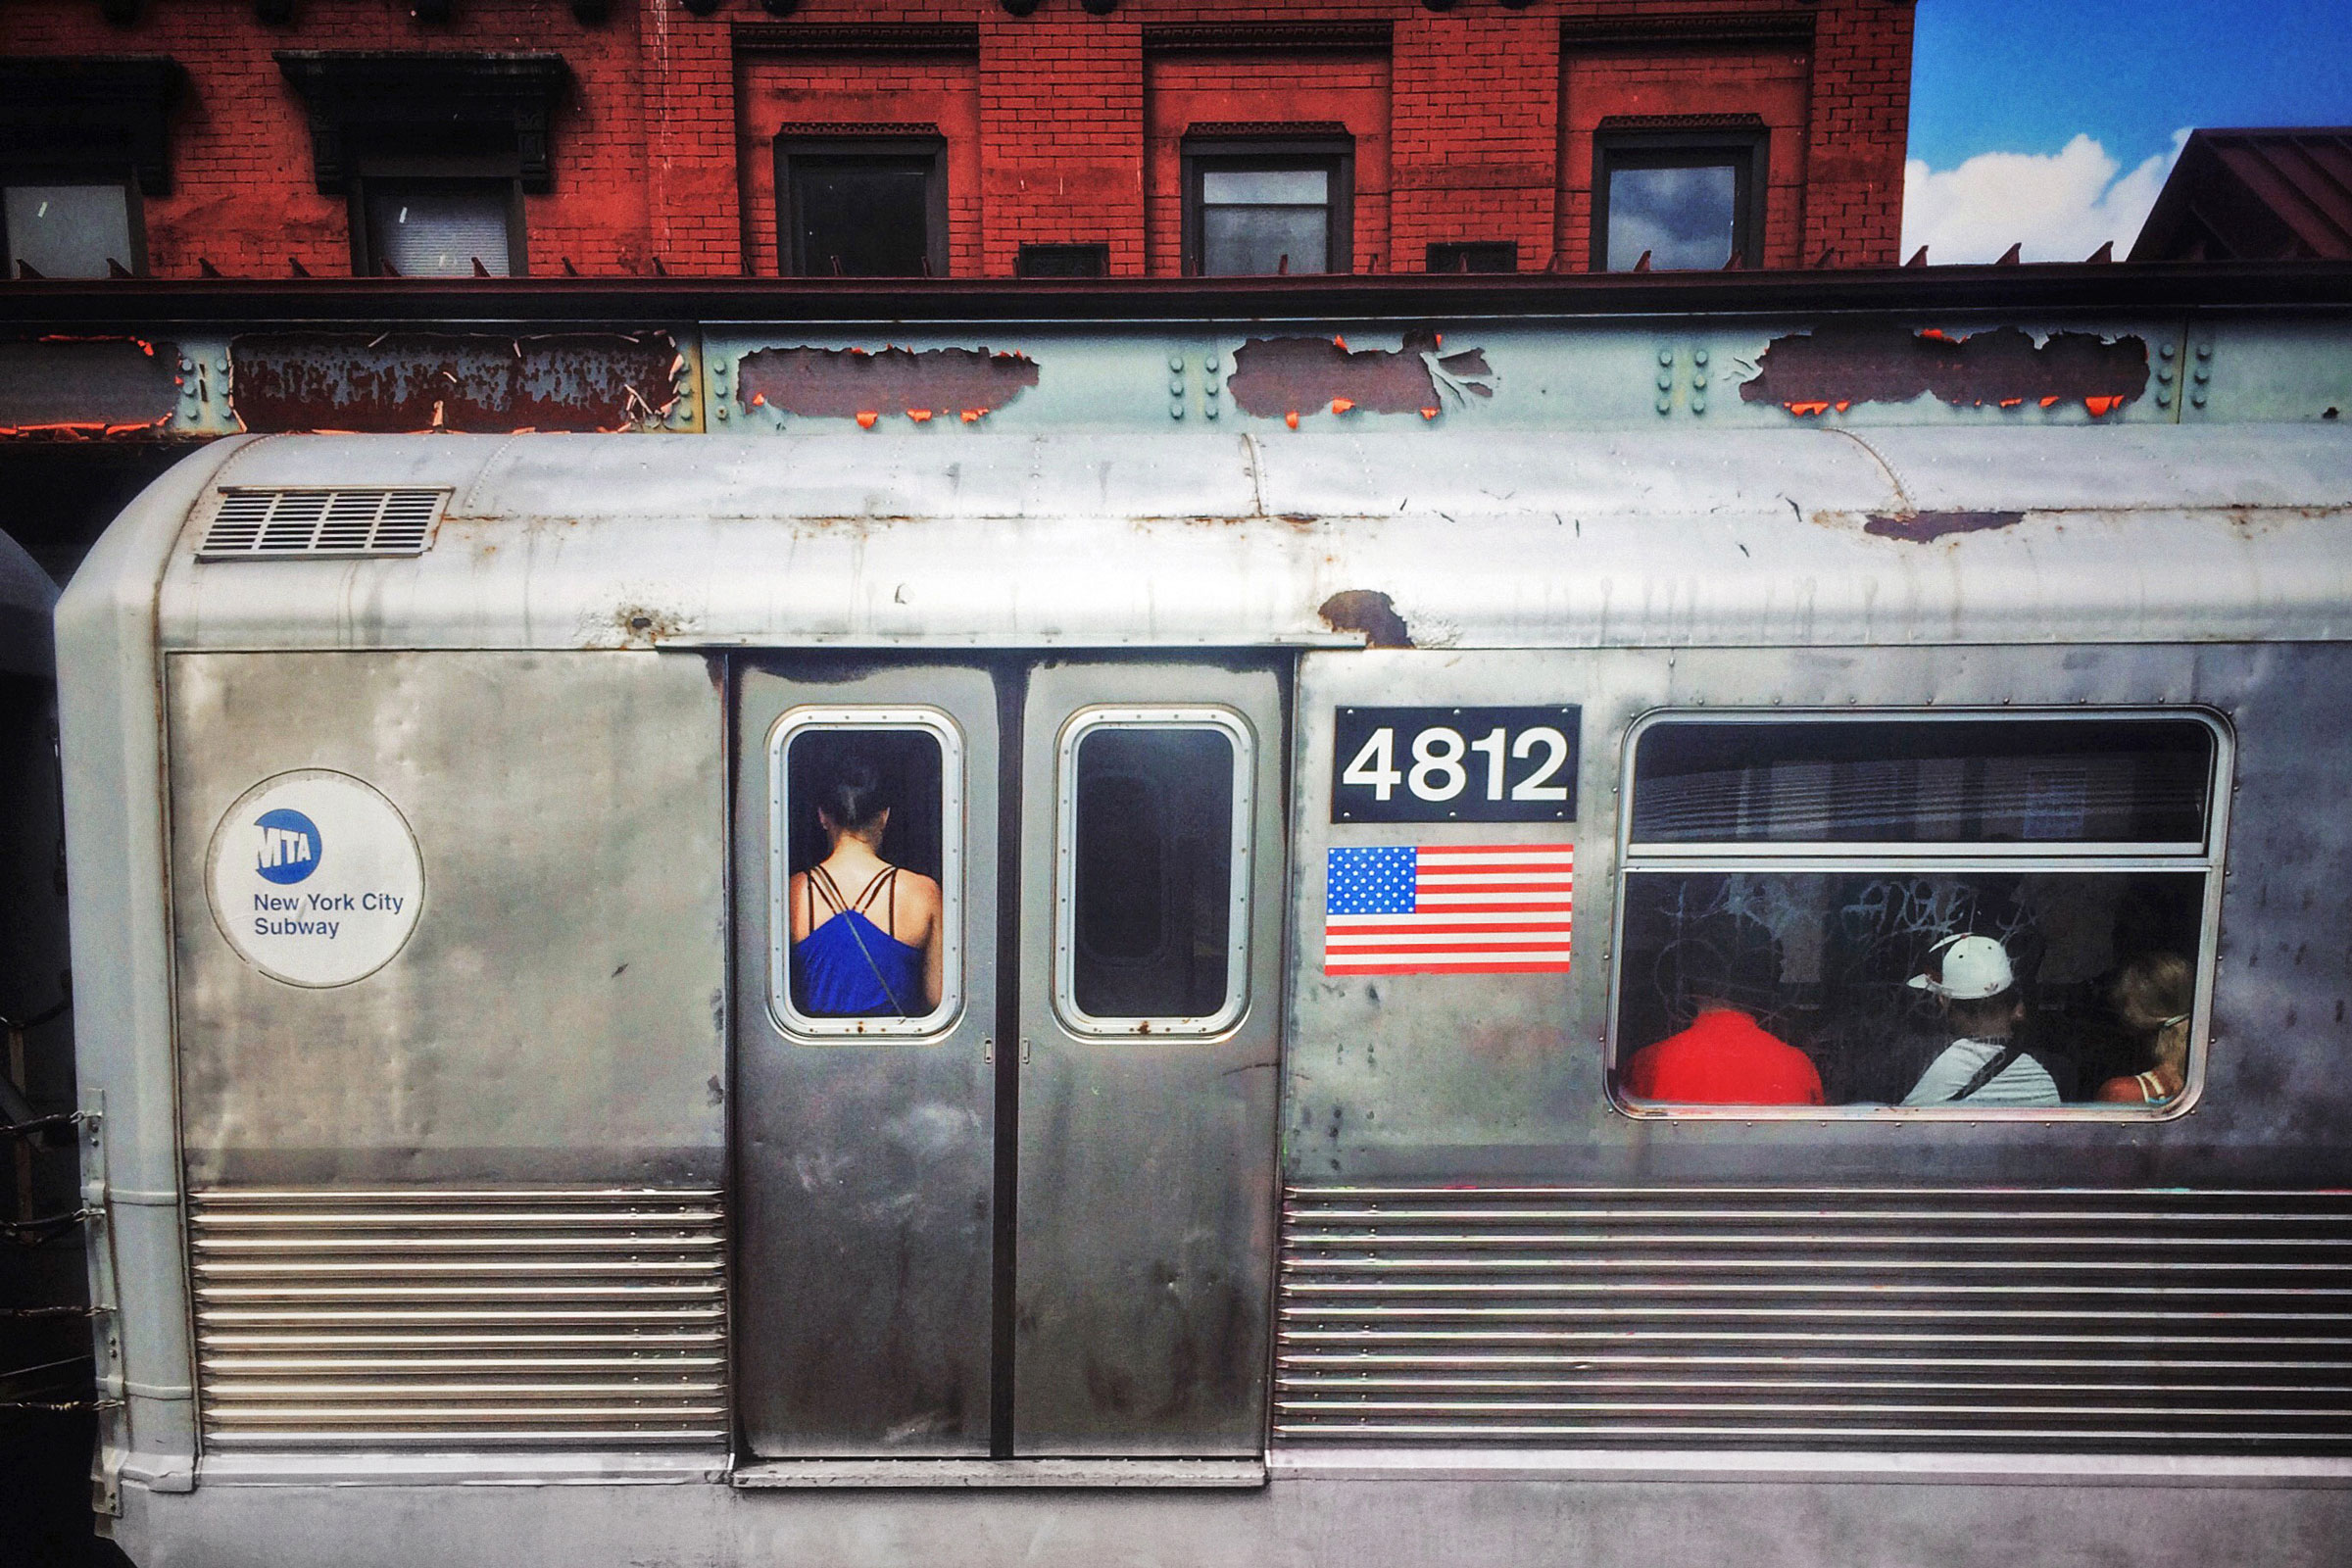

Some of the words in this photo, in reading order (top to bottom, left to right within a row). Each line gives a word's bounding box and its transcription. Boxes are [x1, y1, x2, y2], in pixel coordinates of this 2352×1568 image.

[1343, 726, 1568, 802] 4812
[254, 824, 312, 869] MTA
[254, 893, 299, 911] New
[308, 893, 355, 911] York
[362, 893, 404, 914] City
[255, 917, 340, 940] Subway
